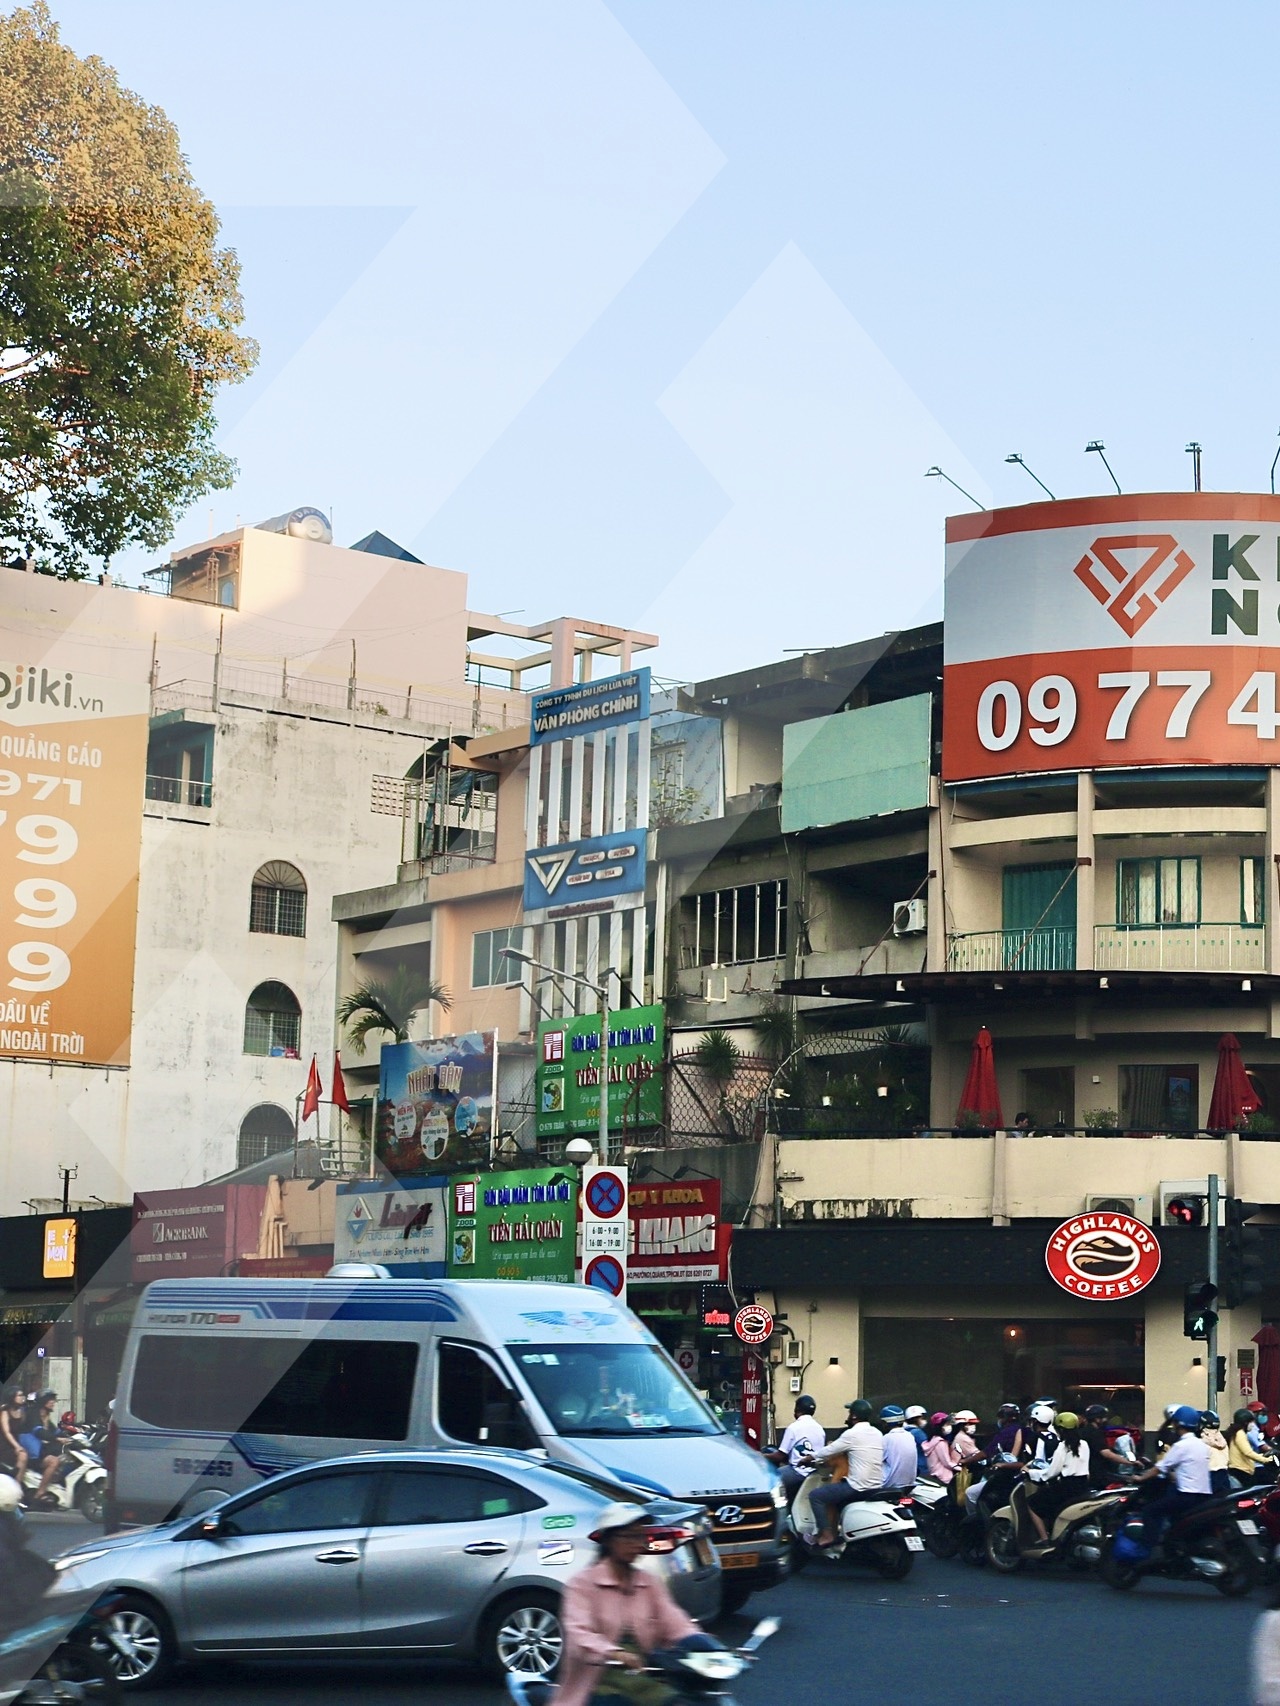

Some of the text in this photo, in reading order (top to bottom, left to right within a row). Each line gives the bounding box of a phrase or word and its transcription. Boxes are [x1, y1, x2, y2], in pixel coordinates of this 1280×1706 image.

[534, 694, 638, 732] VĂN PHÒNG CHÍNH
[976, 674, 1078, 753] 09
[1097, 670, 1211, 740] 77
[0, 732, 102, 768] QUẢNG CÁO
[0, 810, 78, 865] 9
[14, 877, 77, 929] 9
[7, 941, 71, 992] 9
[30, 1000, 51, 1025] VỀ
[1, 1028, 84, 1055] NGOÀI TRỜI
[663, 1188, 703, 1204] KHOA
[639, 1213, 716, 1255] KHANG
[1052, 1216, 1155, 1253] HIGHLANDS
[1064, 1274, 1143, 1296] COFFEE
[737, 1307, 771, 1323] HIGHLANDS
[741, 1332, 767, 1341] COFFEE
